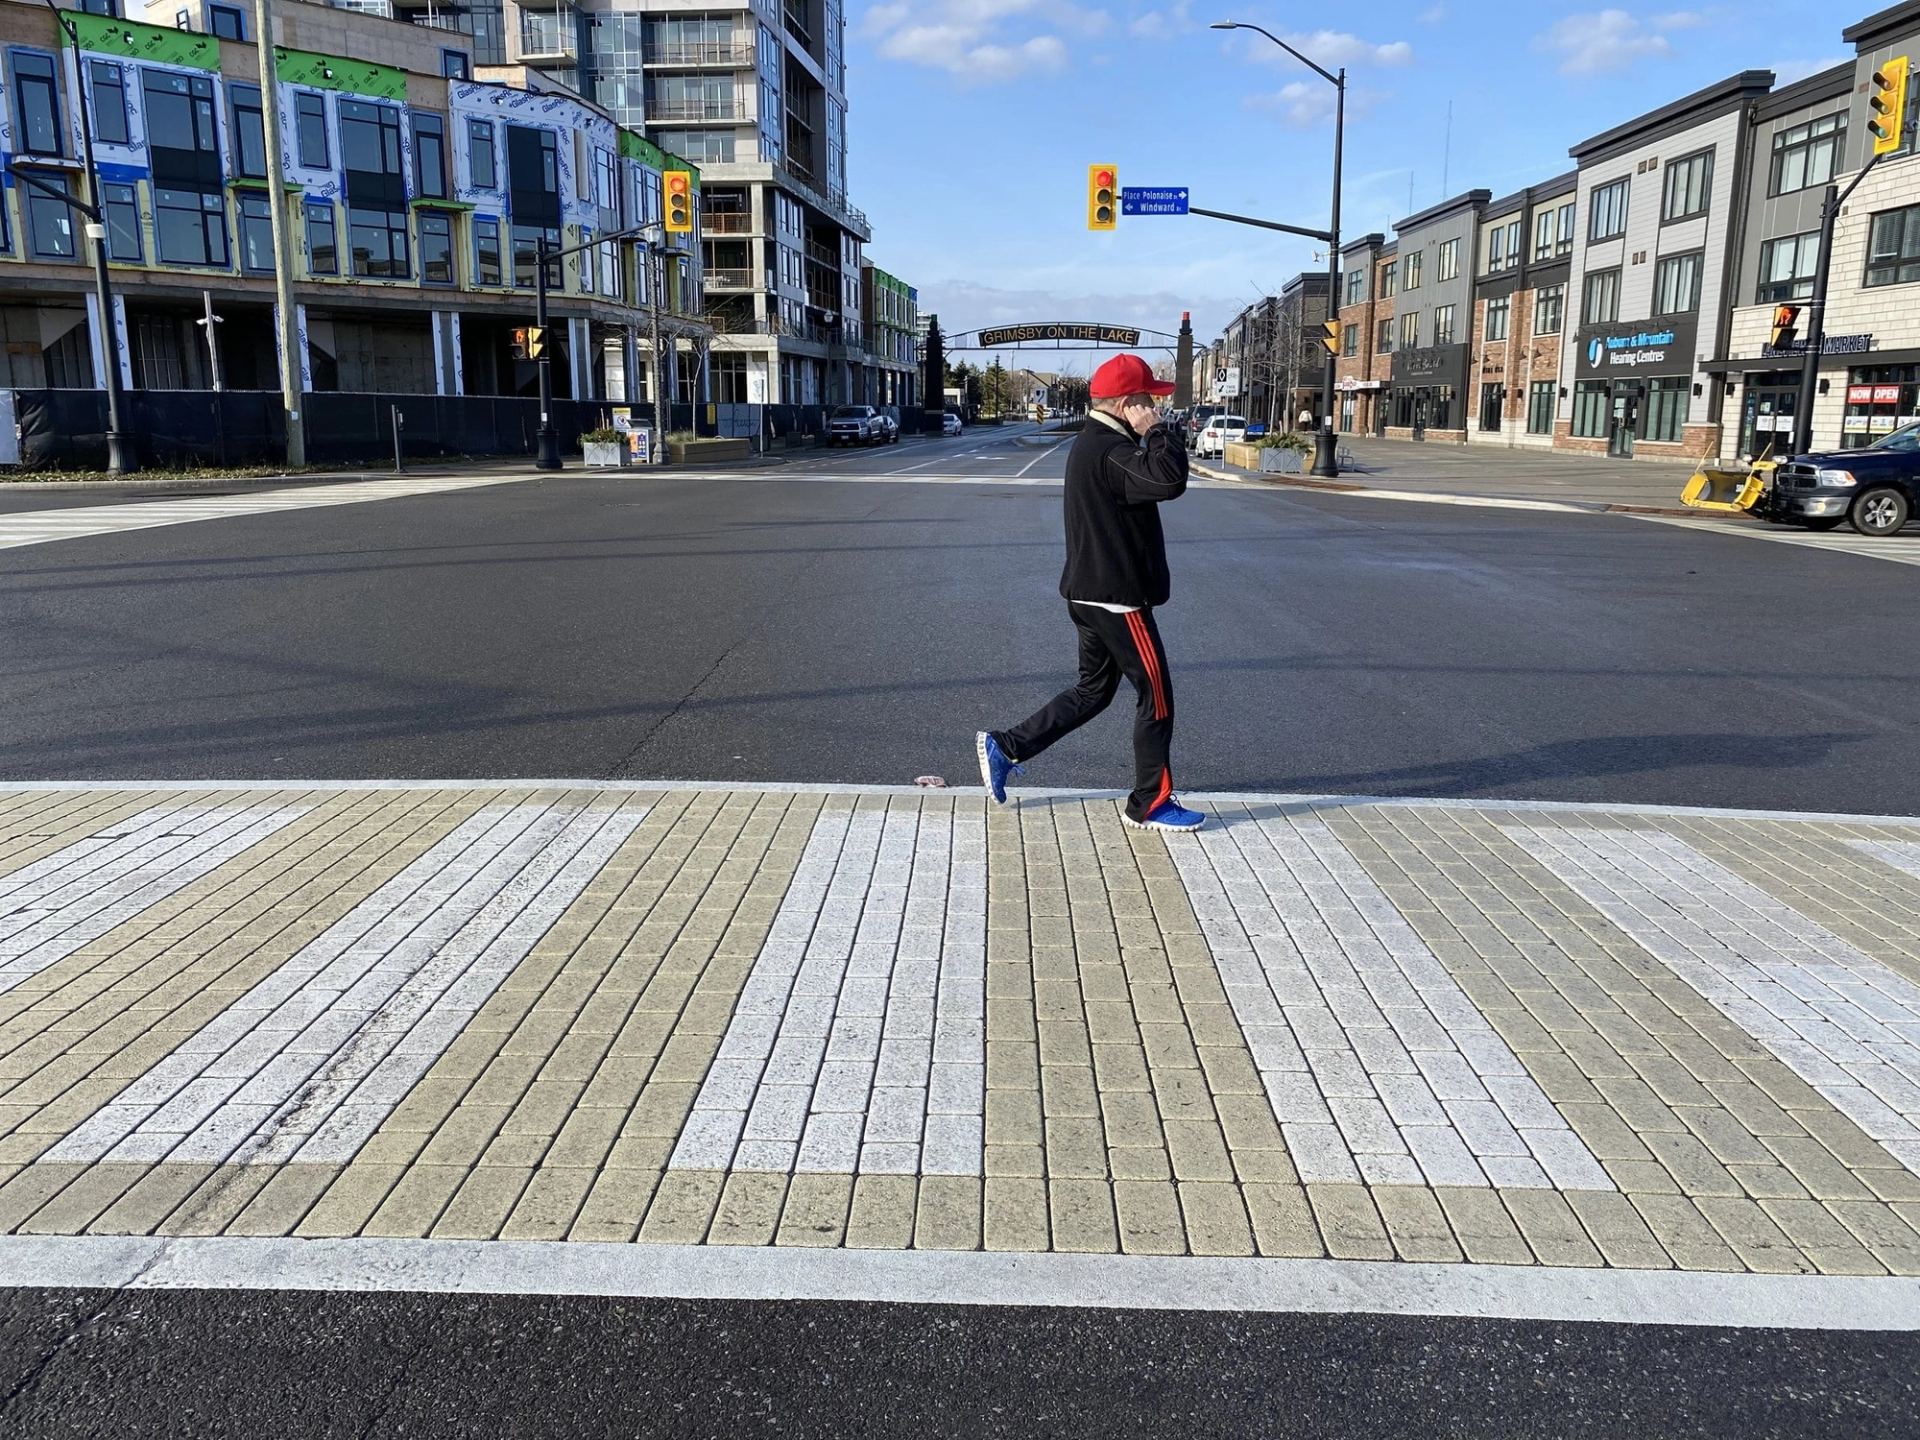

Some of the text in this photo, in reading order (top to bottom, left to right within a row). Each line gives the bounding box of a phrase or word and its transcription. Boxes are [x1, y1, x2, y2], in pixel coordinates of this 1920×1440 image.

[1123, 191, 1140, 200] Place
[1142, 190, 1173, 200] Polonaise
[1140, 202, 1175, 212] Windward
[984, 326, 1134, 344] GRIMSBY ON THE LAKE
[1630, 335, 1637, 347] &
[1637, 329, 1674, 346] Mountain
[1824, 333, 1872, 354] MARKET
[1610, 349, 1665, 367] Hearing Centres
[1850, 388, 1899, 399] NOW OPEN
